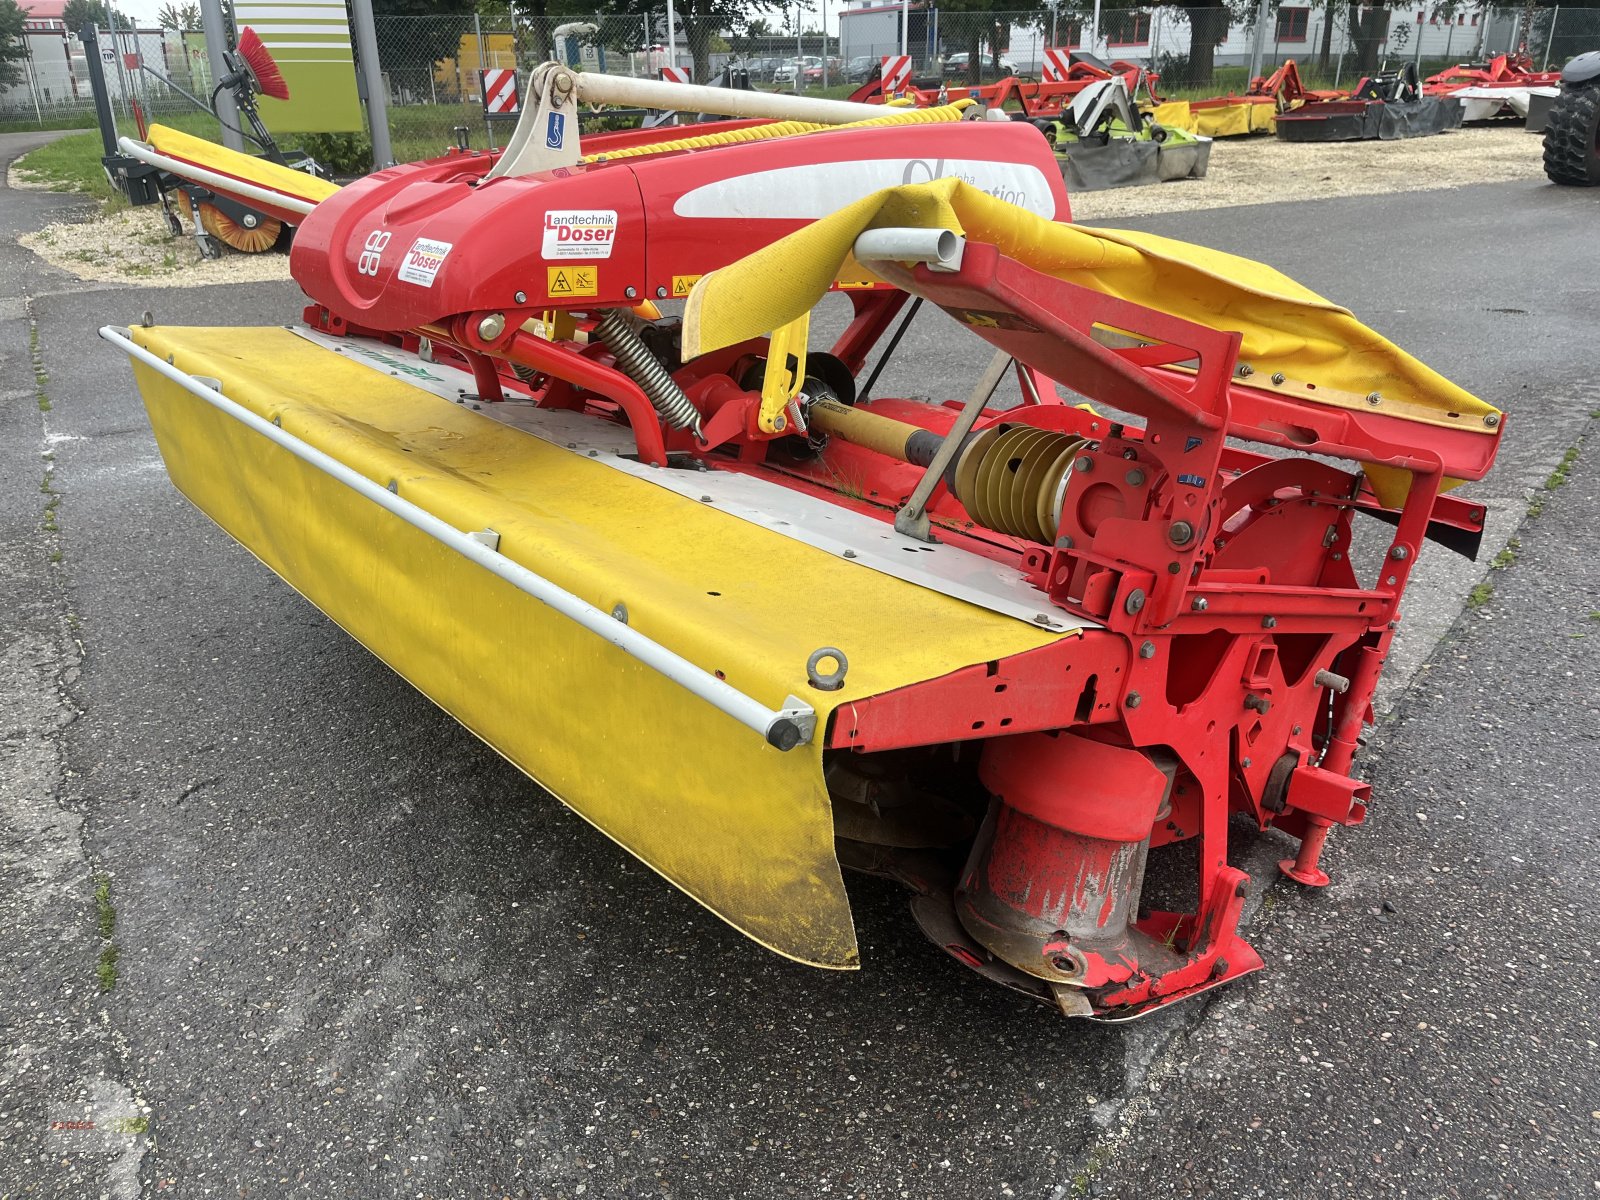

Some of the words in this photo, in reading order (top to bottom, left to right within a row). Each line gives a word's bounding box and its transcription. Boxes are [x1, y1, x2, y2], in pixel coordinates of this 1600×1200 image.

[982, 184, 1026, 208] tion
[546, 214, 614, 230] Landtechnik
[557, 225, 614, 241] Doser
[409, 240, 448, 256] Landtechnik
[409, 250, 442, 271] Doser
